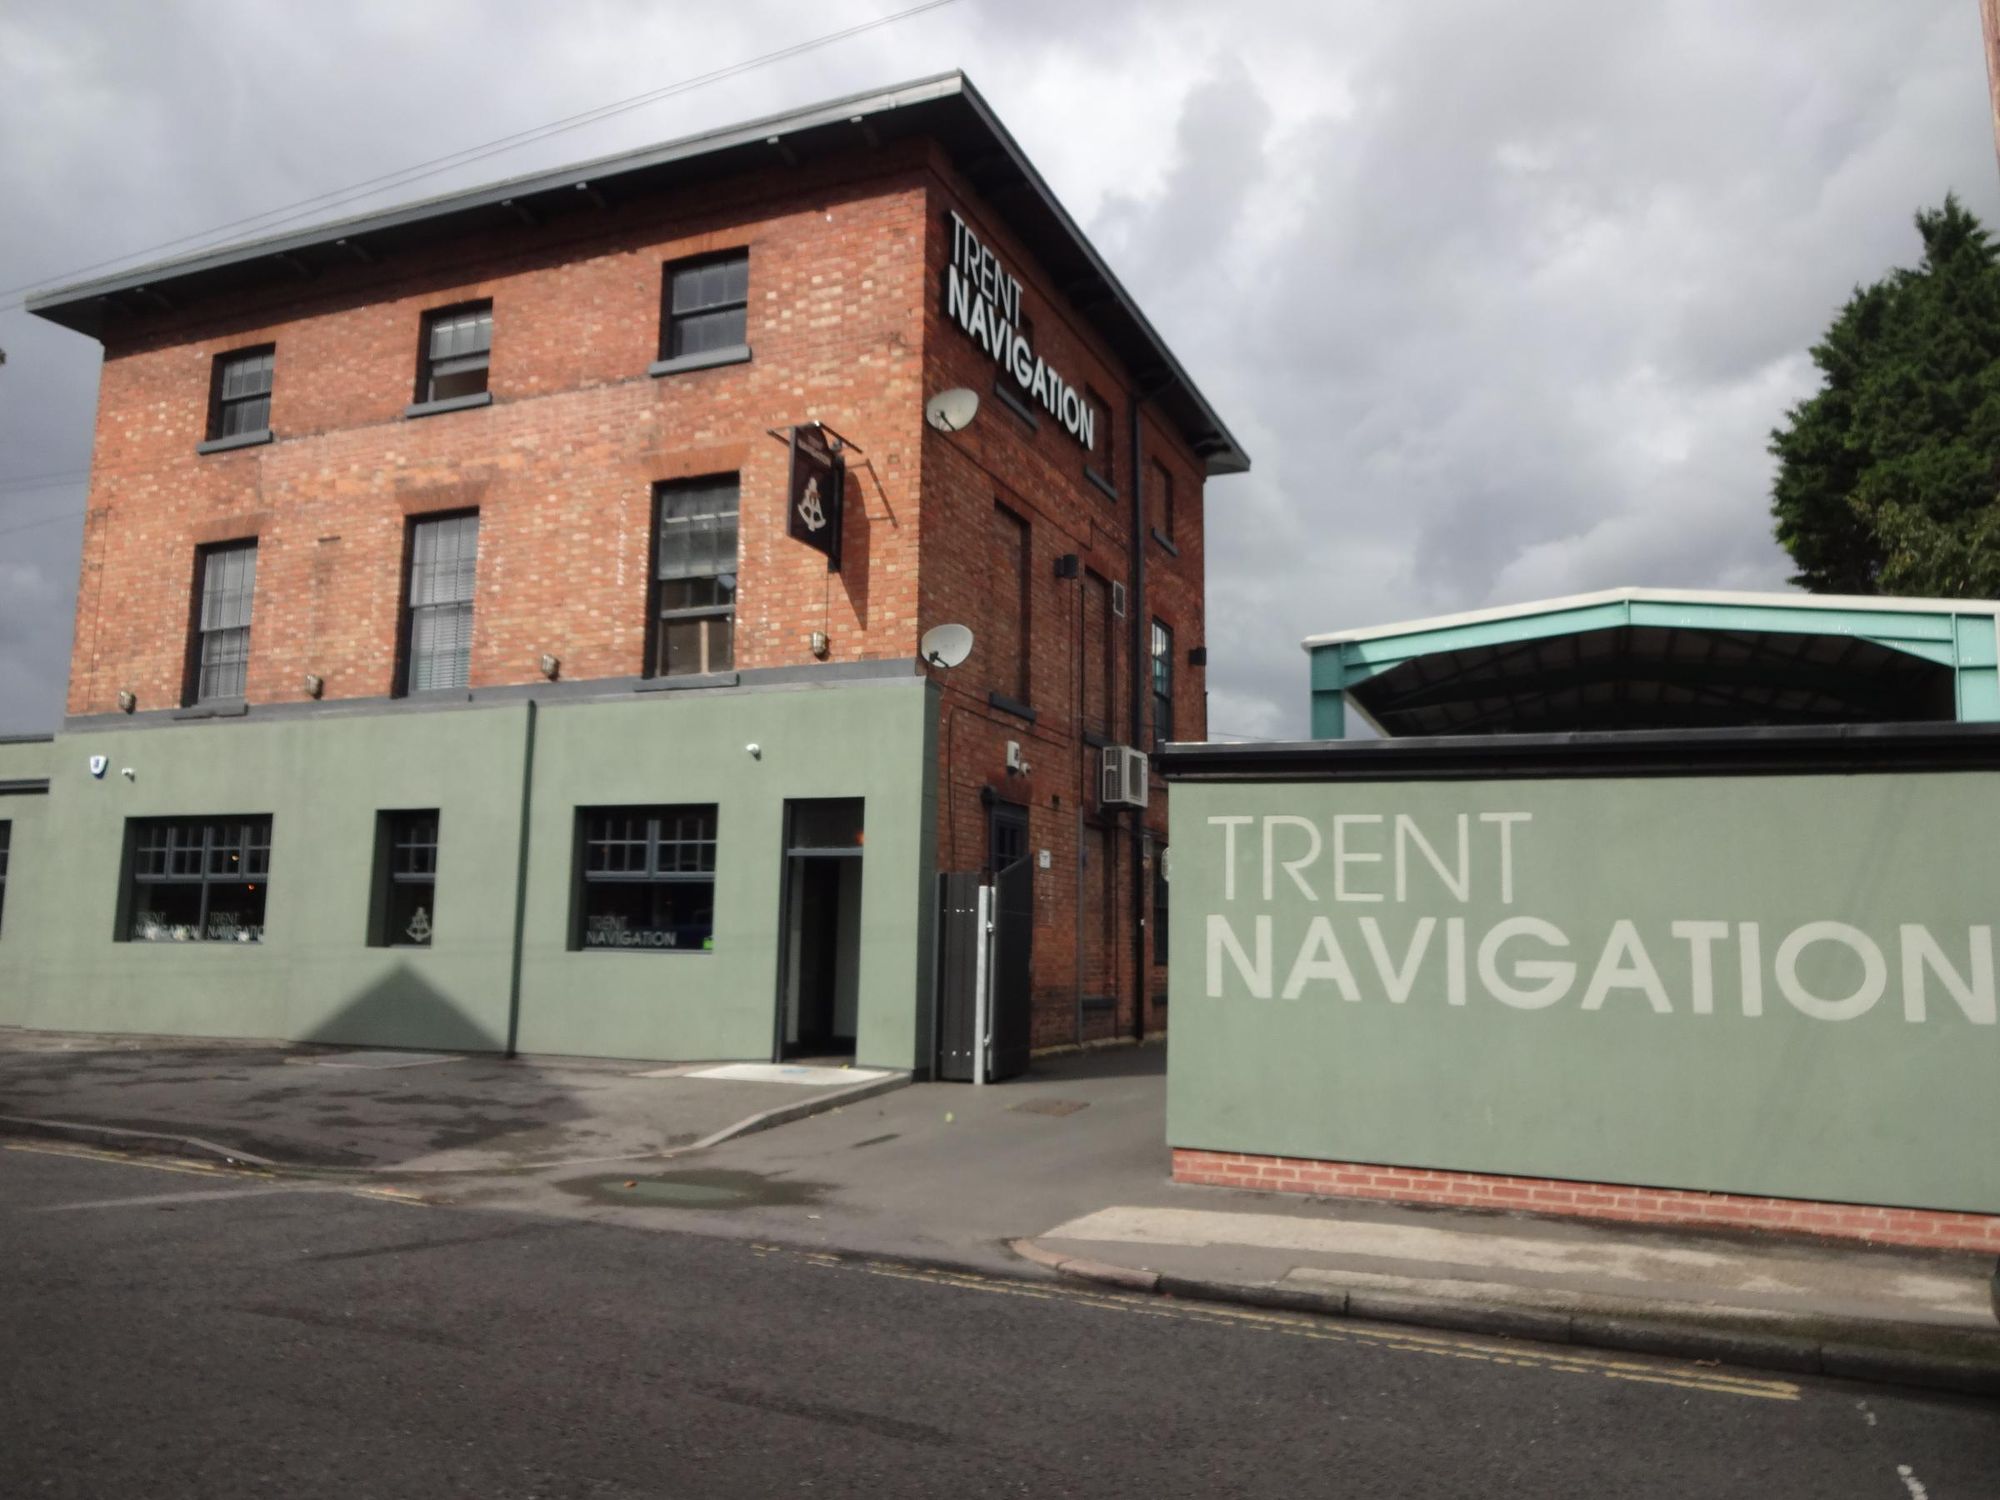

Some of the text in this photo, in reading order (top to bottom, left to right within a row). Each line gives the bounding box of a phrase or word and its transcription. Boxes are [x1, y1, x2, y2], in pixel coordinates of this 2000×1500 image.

[951, 209, 1023, 329] TRENT
[948, 264, 1094, 451] NAVIGATION
[1207, 812, 1533, 904] TRENT
[207, 924, 264, 940] NAVIGATIO
[585, 930, 678, 946] NAVIGATION
[588, 915, 628, 930] TRENT
[1206, 914, 1997, 1025] NAVIGATION
